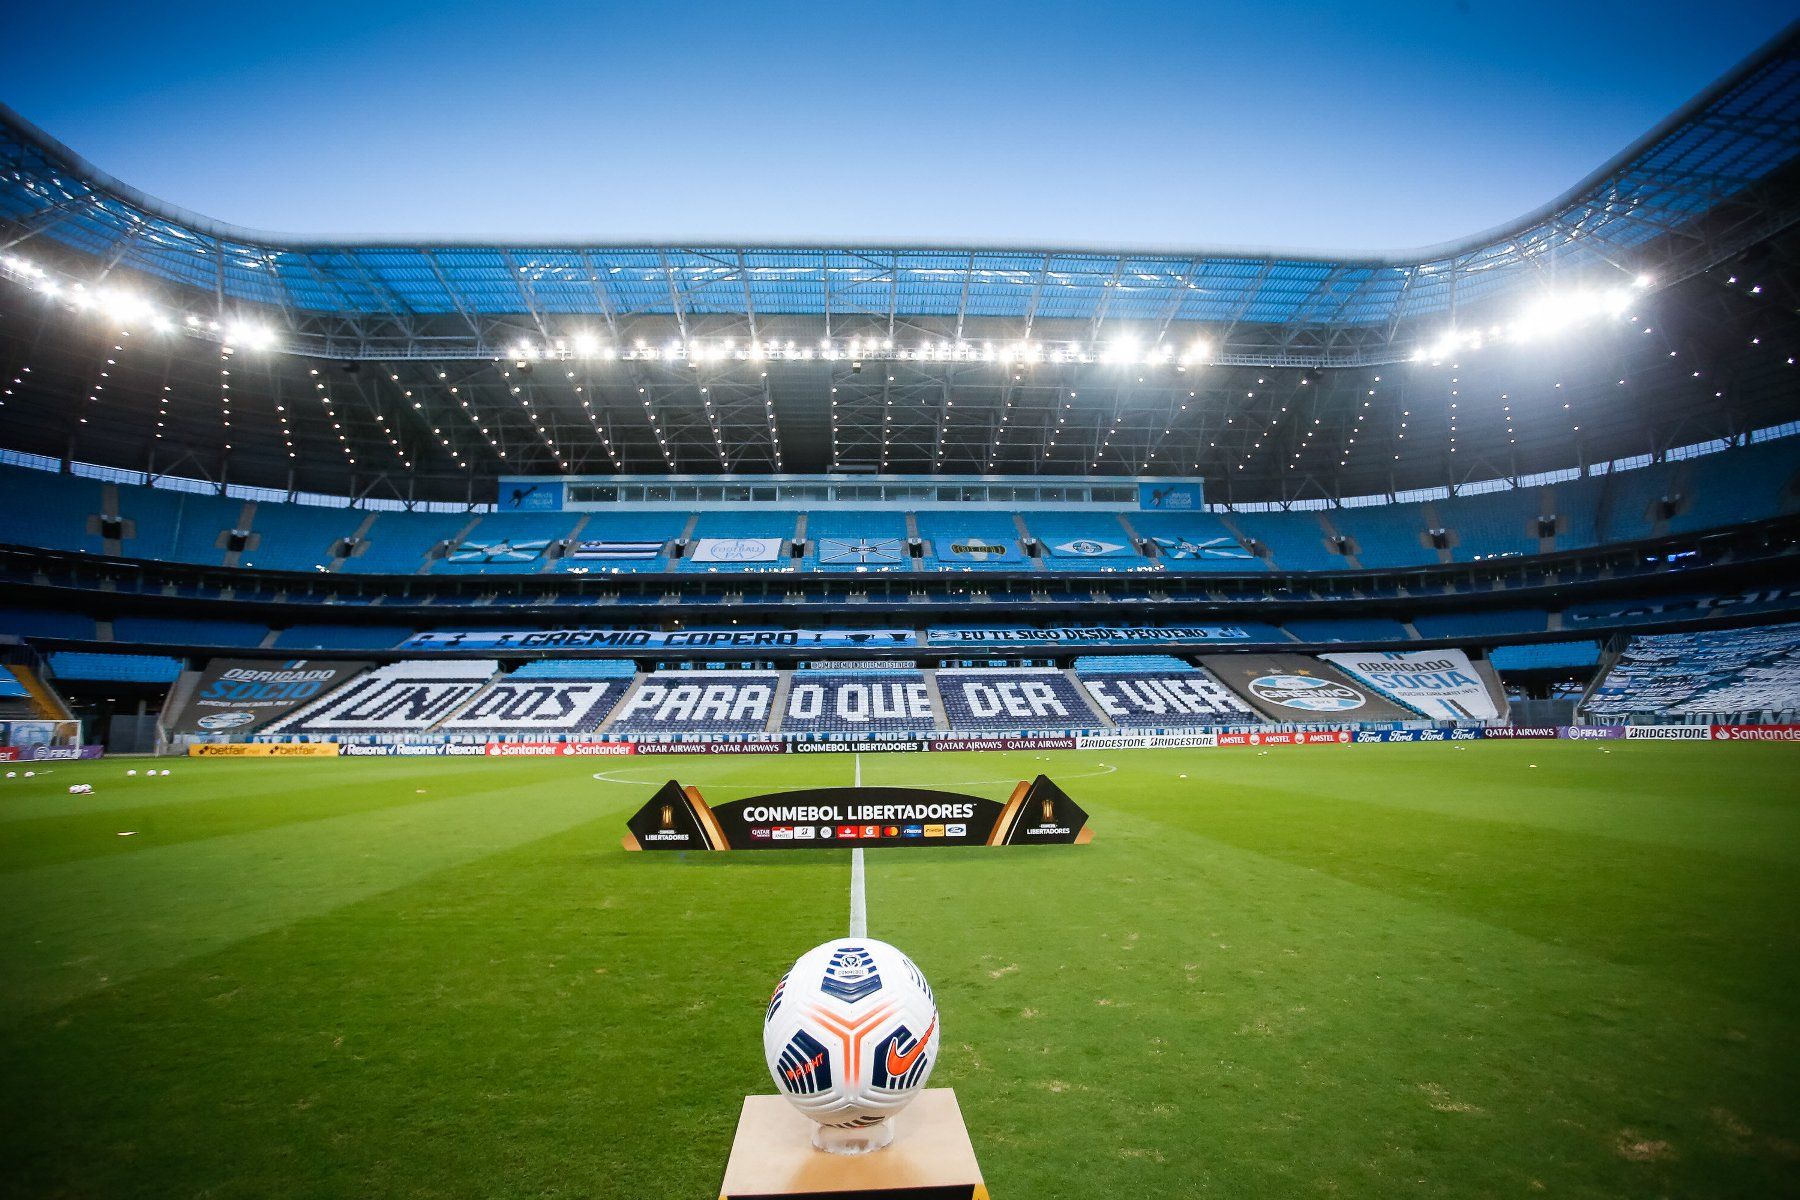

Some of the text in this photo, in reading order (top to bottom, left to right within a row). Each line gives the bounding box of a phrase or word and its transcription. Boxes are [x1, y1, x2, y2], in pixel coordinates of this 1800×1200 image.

[662, 632, 798, 646] COPERO
[960, 630, 985, 641] EU
[988, 630, 1014, 641] TE
[1015, 629, 1060, 640] SIGO
[1063, 629, 1122, 640] DESDE
[1357, 659, 1455, 673] OBRIGADO
[223, 668, 336, 681] OBRIGADO
[615, 684, 773, 722] PARA
[790, 684, 825, 721] O
[837, 684, 933, 723] QUE
[963, 682, 1070, 718] DER
[1083, 680, 1130, 715] E
[1117, 679, 1253, 716] VIER
[1310, 734, 1334, 742] AMSTEL
[1357, 731, 1382, 742] Ford
[1389, 730, 1413, 741] Ford
[1420, 729, 1444, 741] Ford
[1451, 728, 1475, 740] Ford
[1485, 728, 1554, 738] QATAR AIRWAYS
[1628, 727, 1708, 739] BRIDGESTONE
[1007, 740, 1072, 749] QATAR AIRWAYS
[1080, 738, 1146, 748] BRIDGESTONE
[1150, 737, 1214, 747] BRIDGESTONE
[1220, 736, 1245, 745] AMSTEL
[1265, 735, 1290, 743] AMSTEL
[210, 745, 247, 755] betfair
[279, 745, 317, 755] betfair
[347, 744, 387, 755] Rexona
[397, 744, 437, 755] Rexona
[446, 744, 485, 755] Rexona
[502, 744, 556, 755] Santander
[575, 744, 630, 755] Santander
[638, 744, 706, 754] QATAR AIRWAYS
[711, 744, 779, 753] QATAR AIRWAYS
[798, 742, 918, 752] CONMEBOL LIBERTADORES
[935, 741, 1002, 751] QATAR AIRWAYS
[743, 804, 974, 822] CONMEBOL LIBERTADORES
